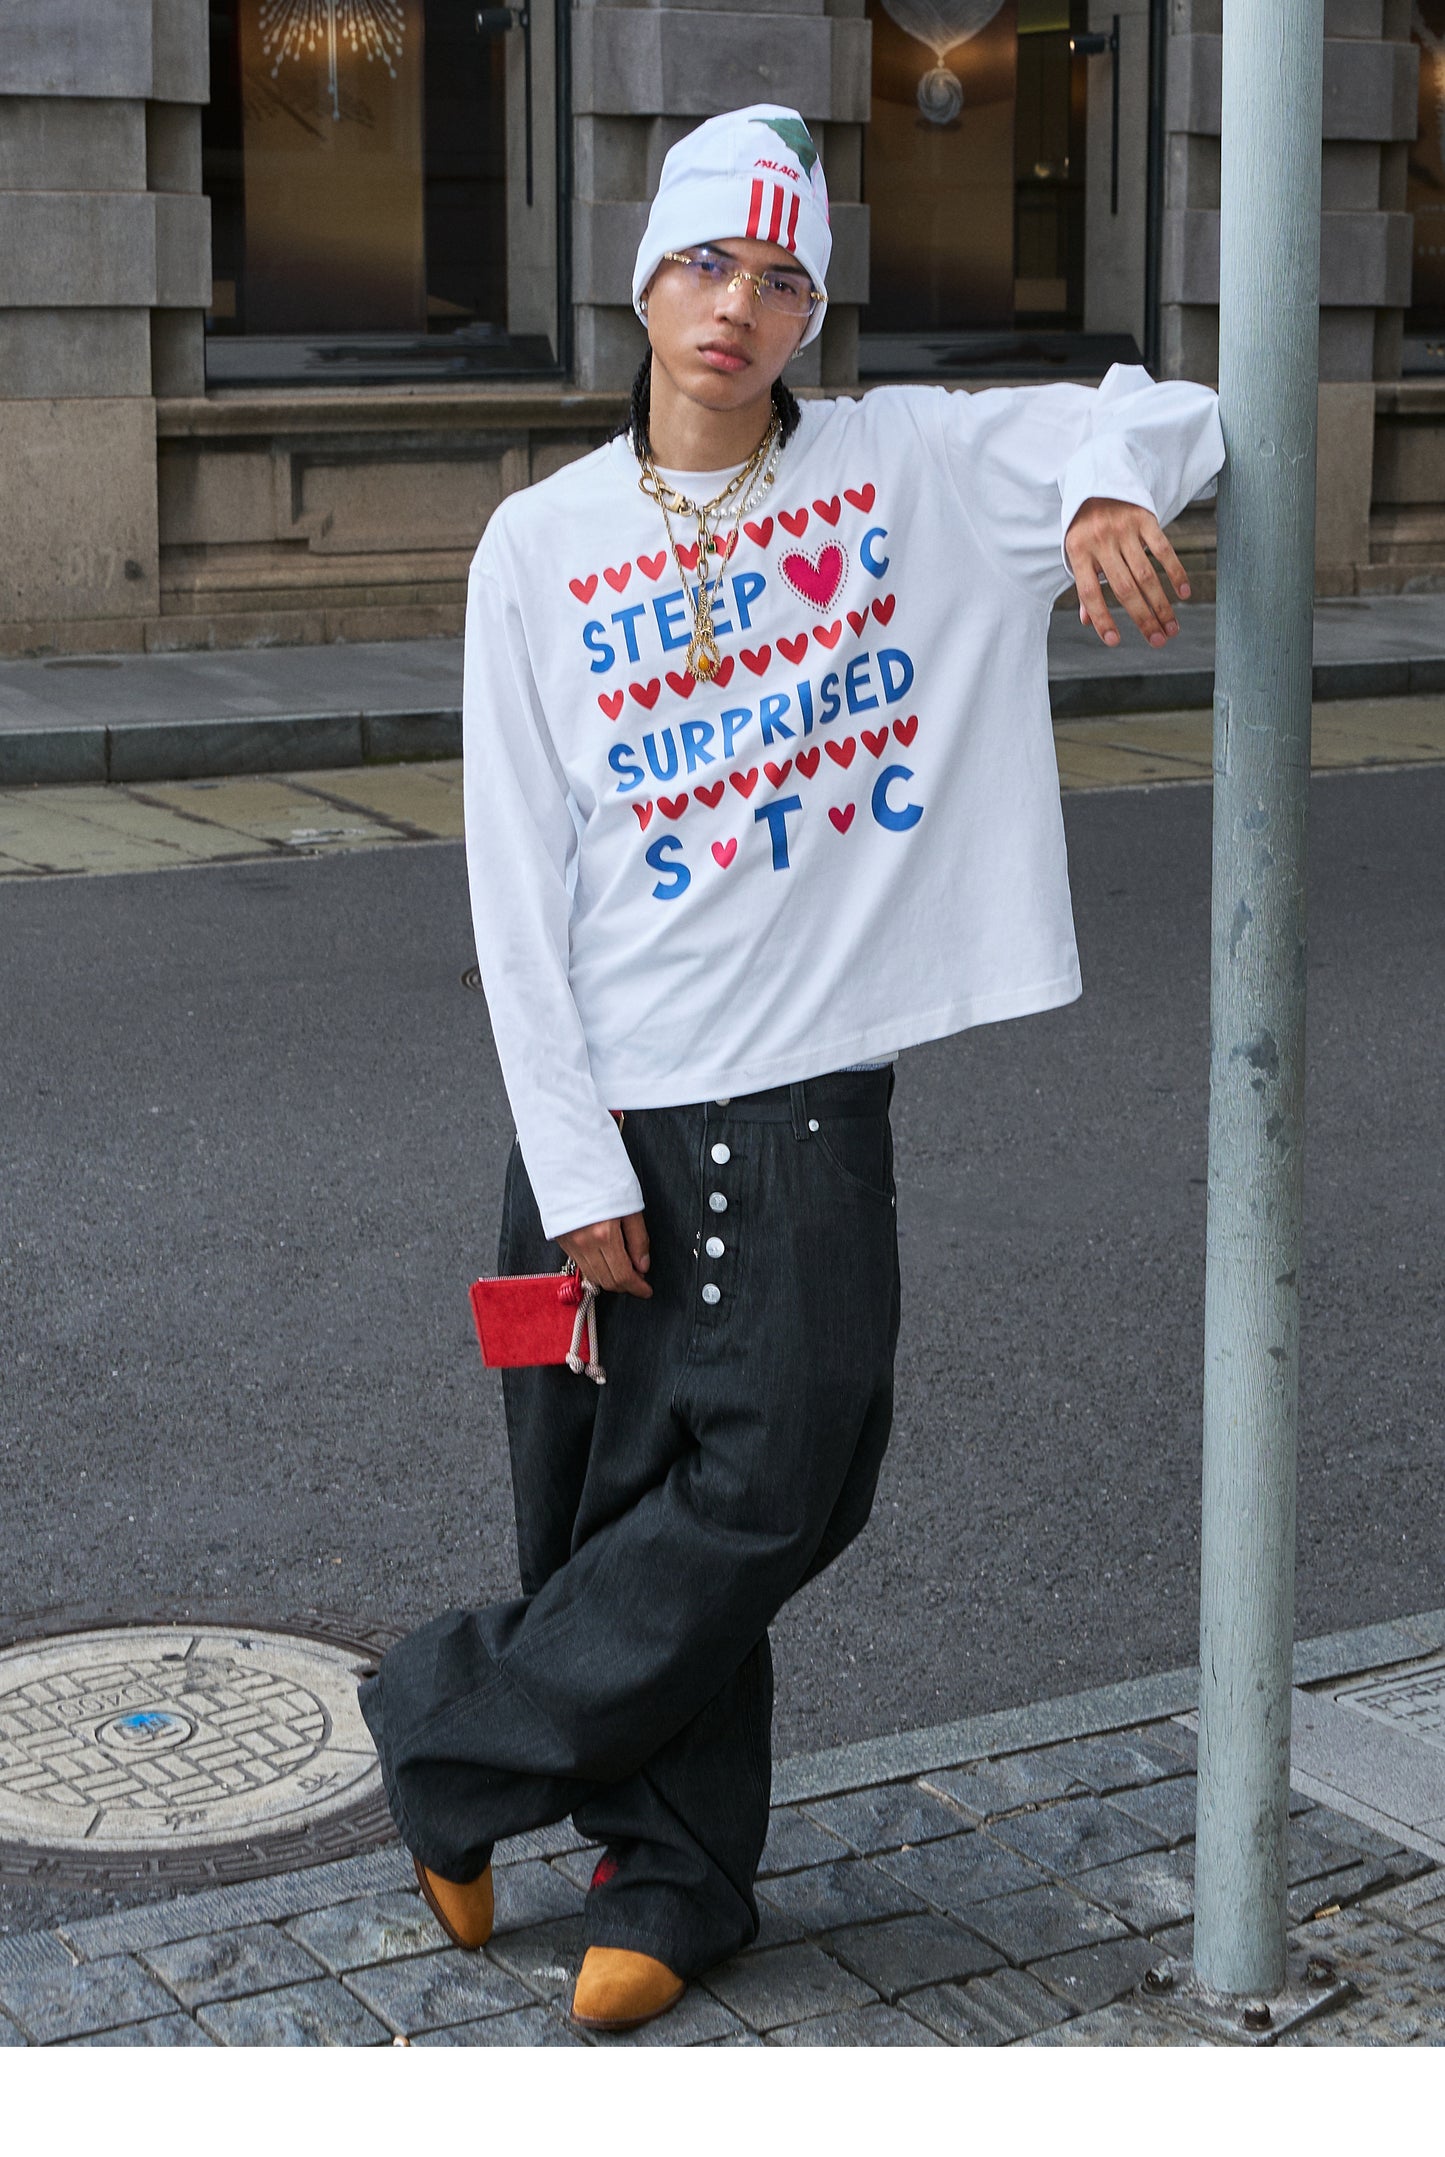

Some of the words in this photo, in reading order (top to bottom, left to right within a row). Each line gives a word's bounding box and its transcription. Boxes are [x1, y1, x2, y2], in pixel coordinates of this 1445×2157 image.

[754, 158, 801, 183] PALACE
[582, 572, 767, 674] STEEP
[859, 527, 890, 579] C
[608, 648, 914, 793] SURPRISED
[645, 834, 691, 901] S
[754, 794, 803, 871] T
[871, 764, 924, 832] C
[57, 1683, 154, 1717] D400
